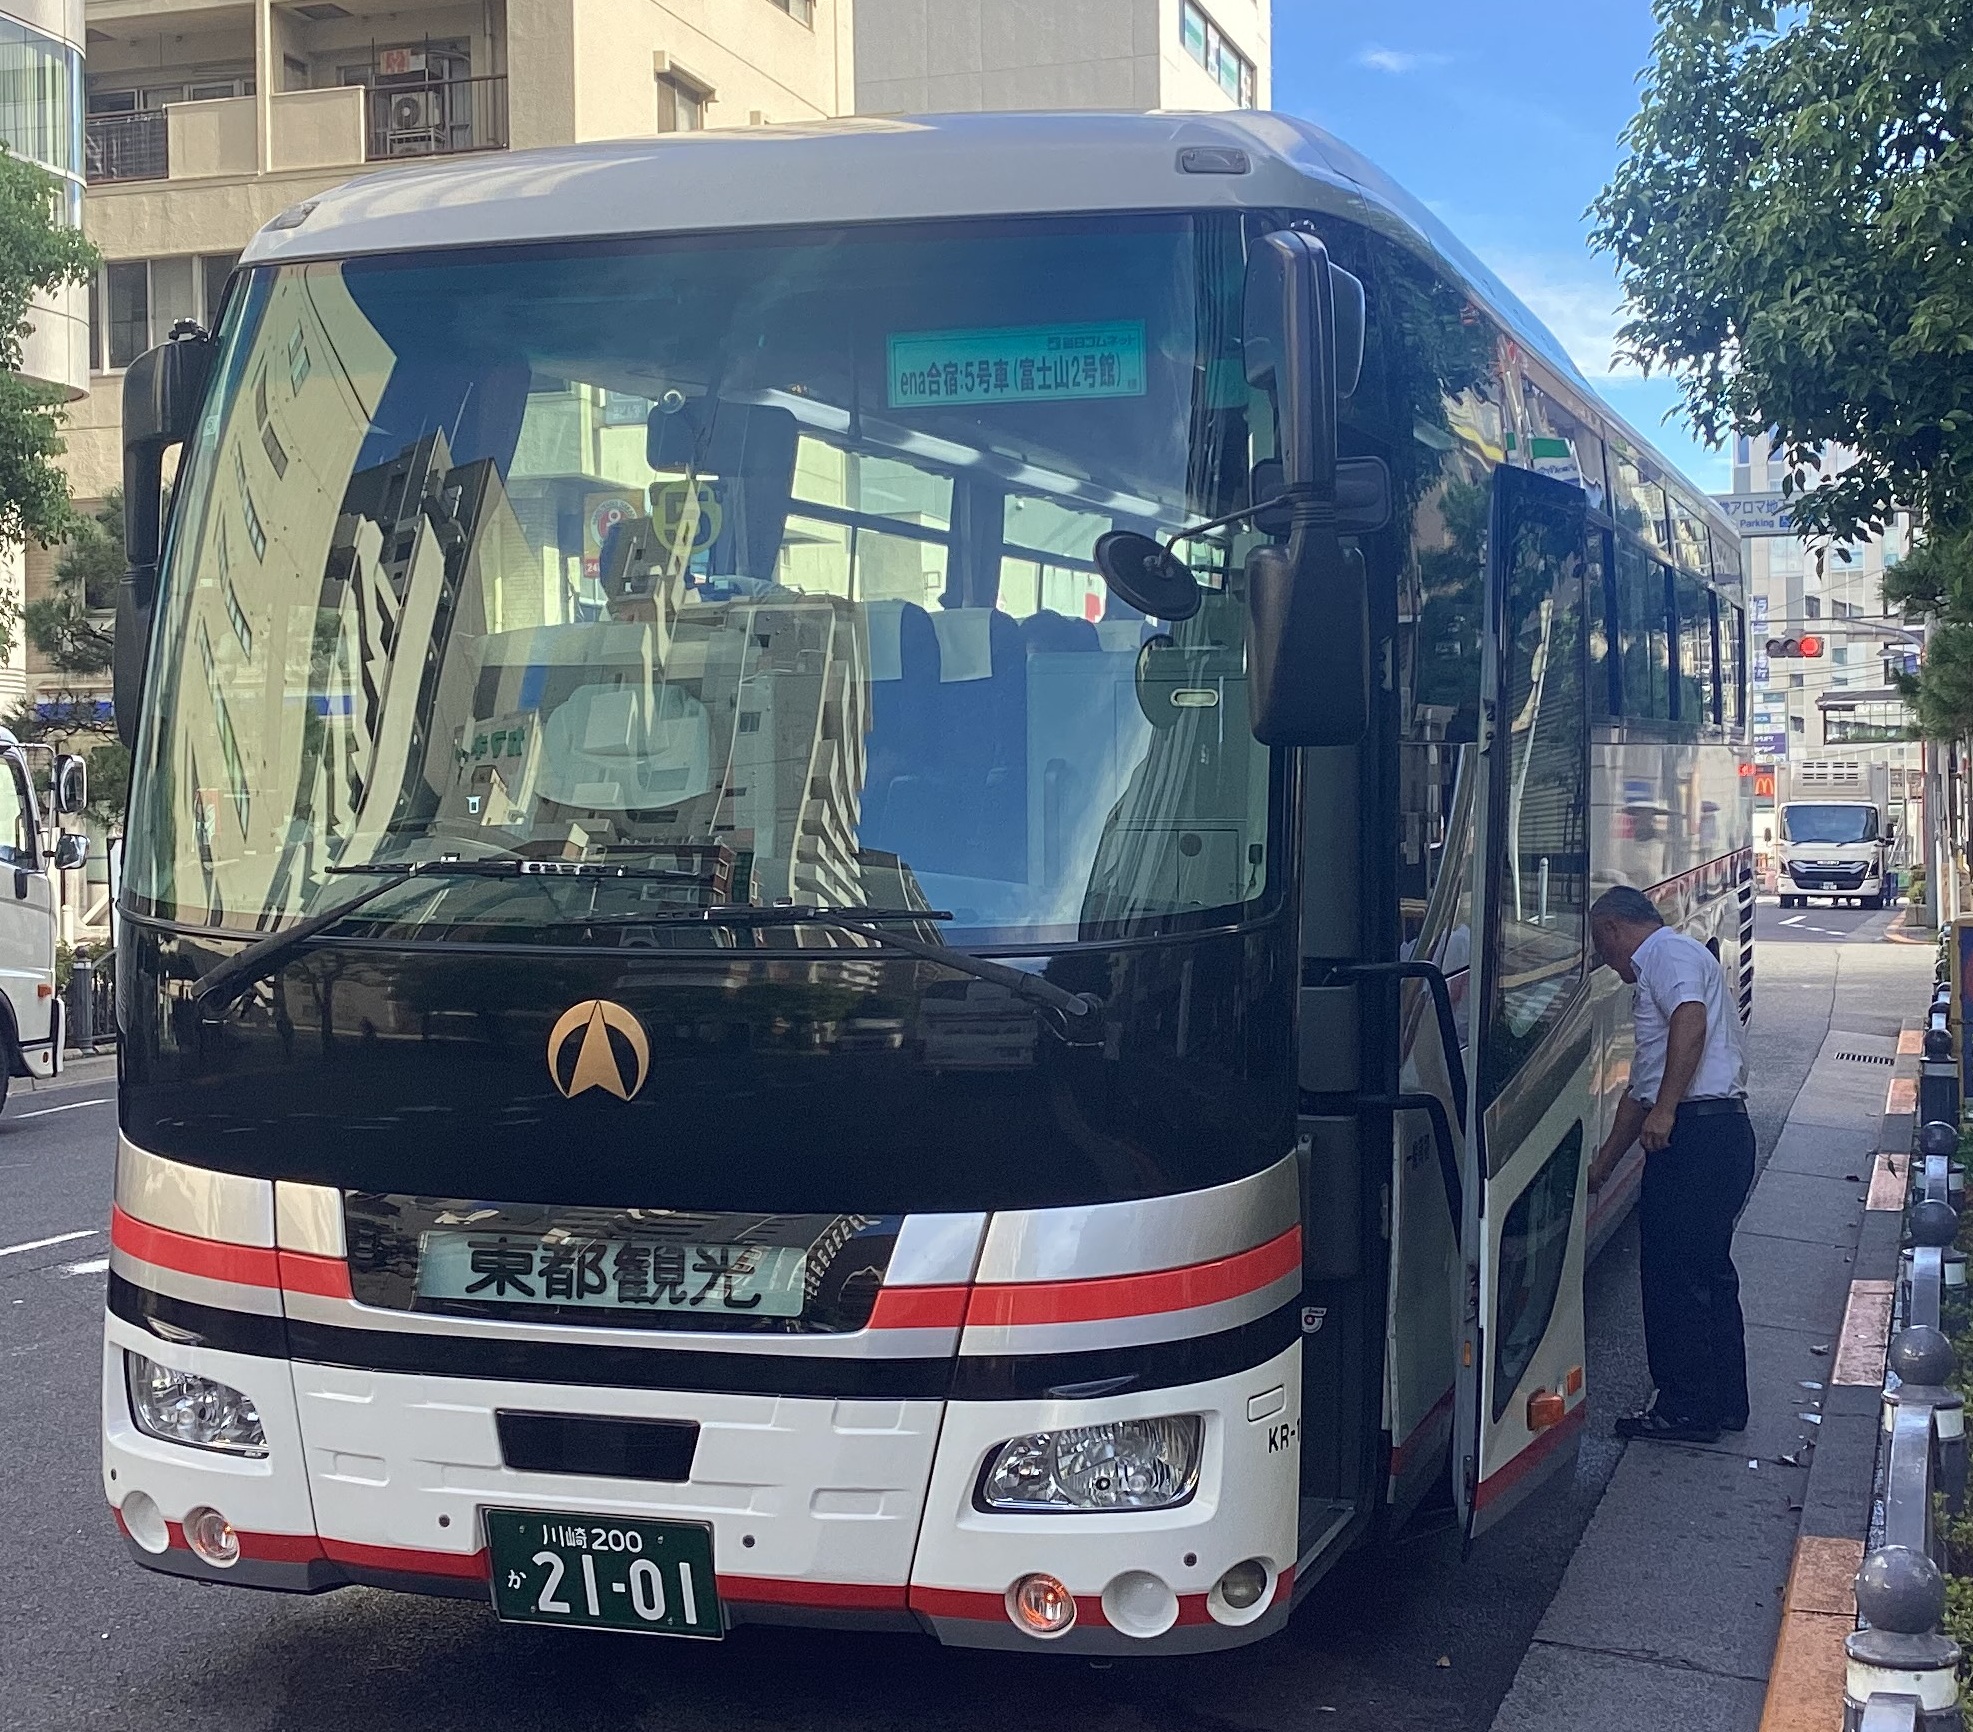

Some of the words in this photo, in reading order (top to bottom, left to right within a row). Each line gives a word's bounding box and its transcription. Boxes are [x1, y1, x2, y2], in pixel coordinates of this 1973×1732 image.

[1740, 519, 1775, 528] Parking
[464, 1237, 762, 1309] 東都観光
[507, 1569, 527, 1589] か
[532, 1551, 698, 1625] 21-01
